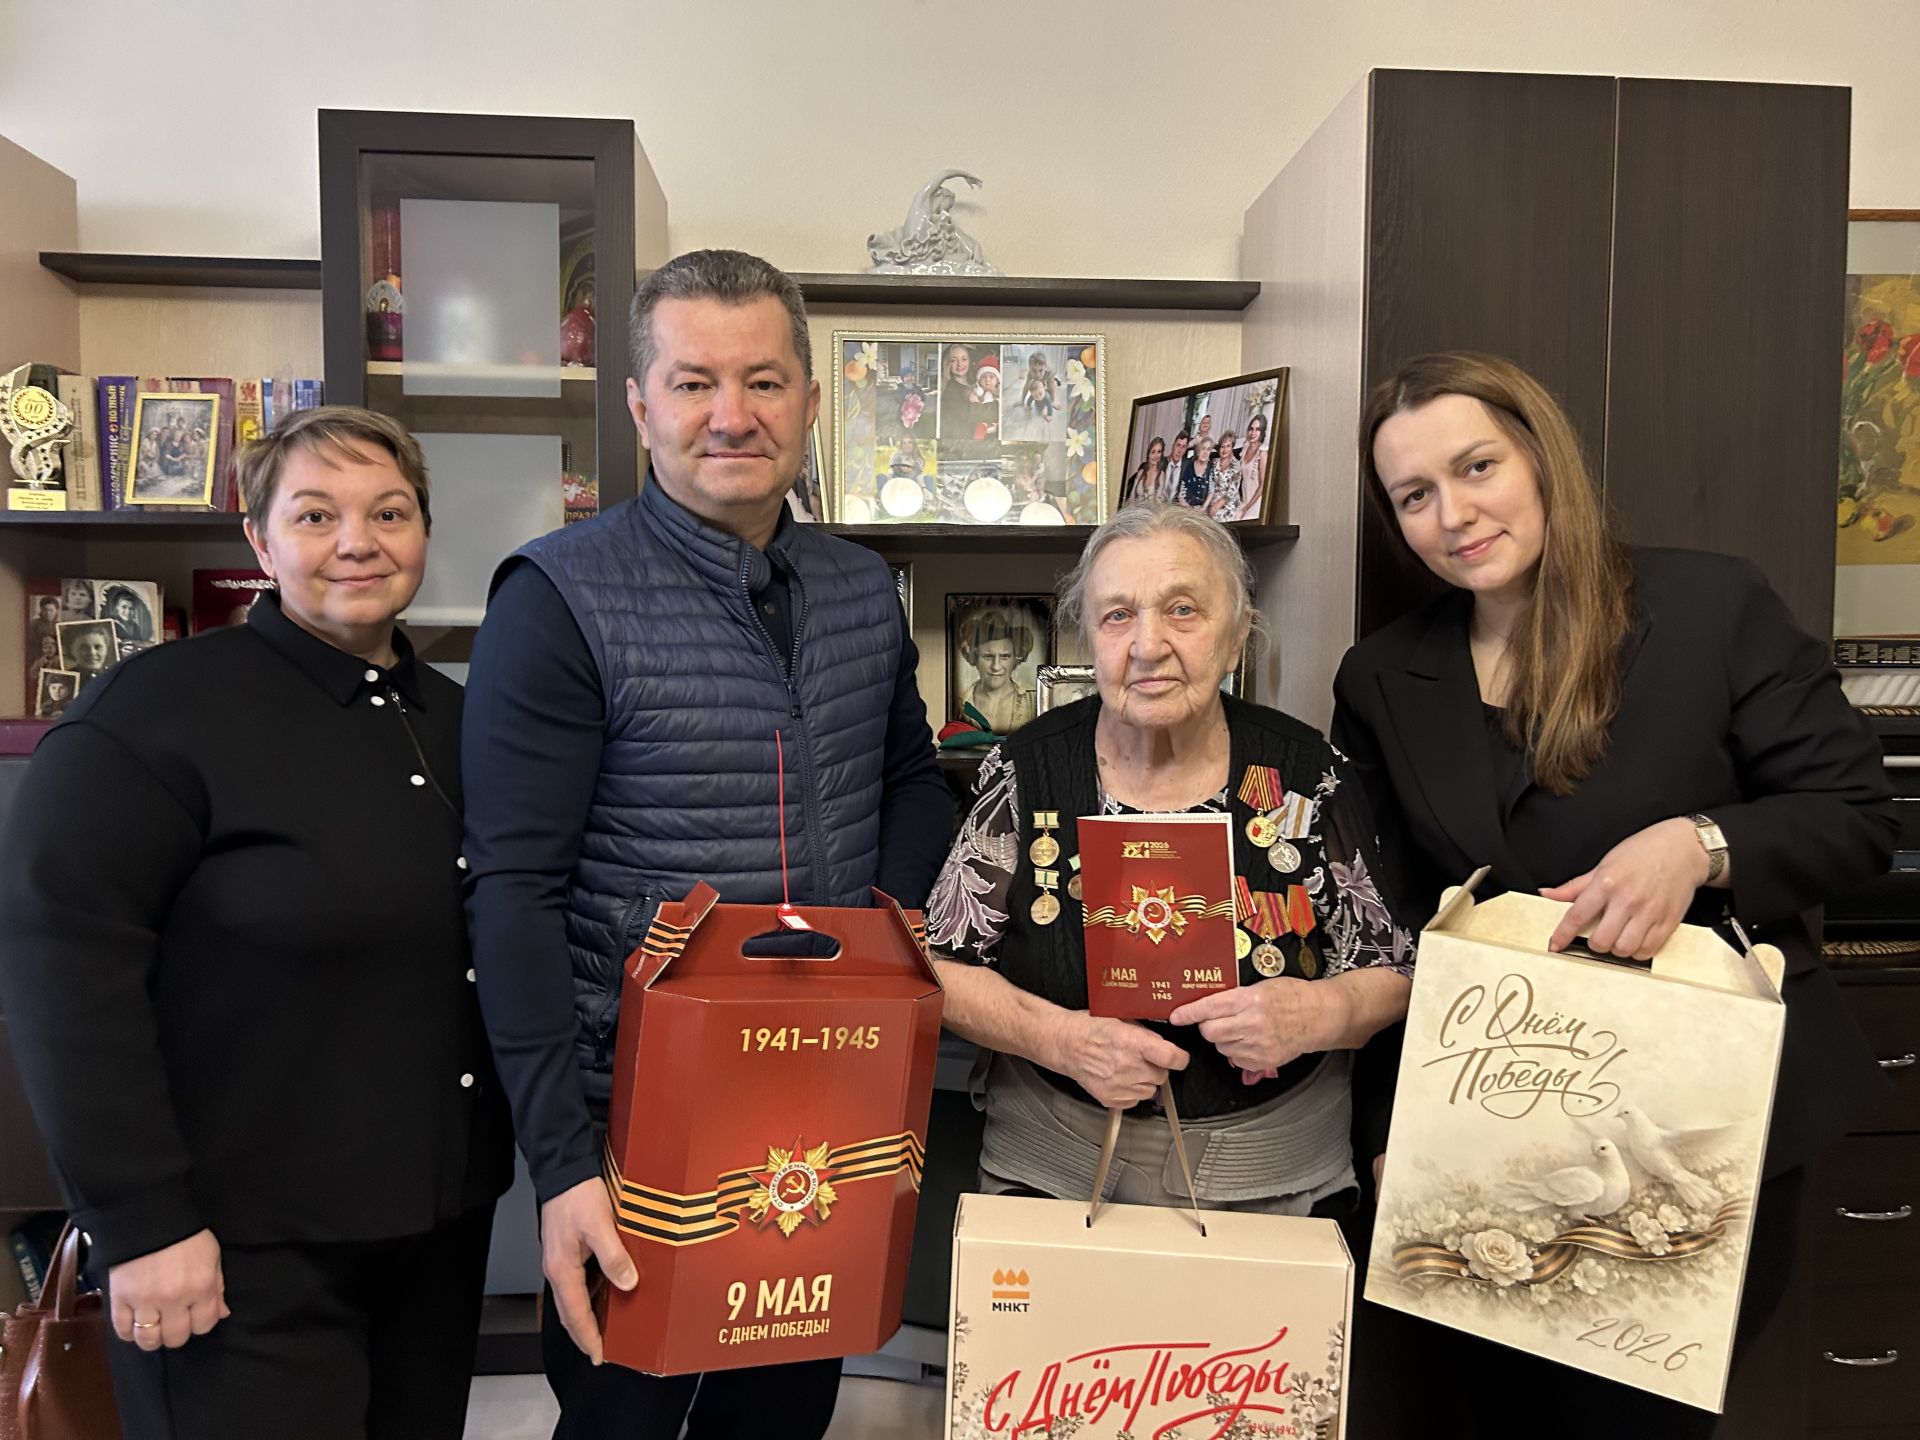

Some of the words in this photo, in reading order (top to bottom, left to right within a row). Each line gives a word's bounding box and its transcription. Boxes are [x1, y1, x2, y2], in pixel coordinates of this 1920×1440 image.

[24, 402, 43, 415] 90
[1110, 967, 1138, 981] МАЯ
[1151, 981, 1170, 989] 1941
[1183, 968, 1192, 982] 9
[1194, 966, 1222, 982] МАЙ
[1439, 984, 1485, 1049] С
[1485, 973, 1617, 1060] Днём
[1422, 1046, 1628, 1119] Победы!
[727, 1281, 747, 1321] 9
[755, 1273, 833, 1318] МАЯ
[992, 1302, 1030, 1312] МНКТ
[718, 1328, 728, 1344] С
[729, 1324, 769, 1345] ДНЕМ
[770, 1318, 830, 1339] ПОБЕДЫ!
[1575, 1317, 1702, 1371] 2026
[983, 1369, 1022, 1432] С
[1011, 1358, 1137, 1440] Днём
